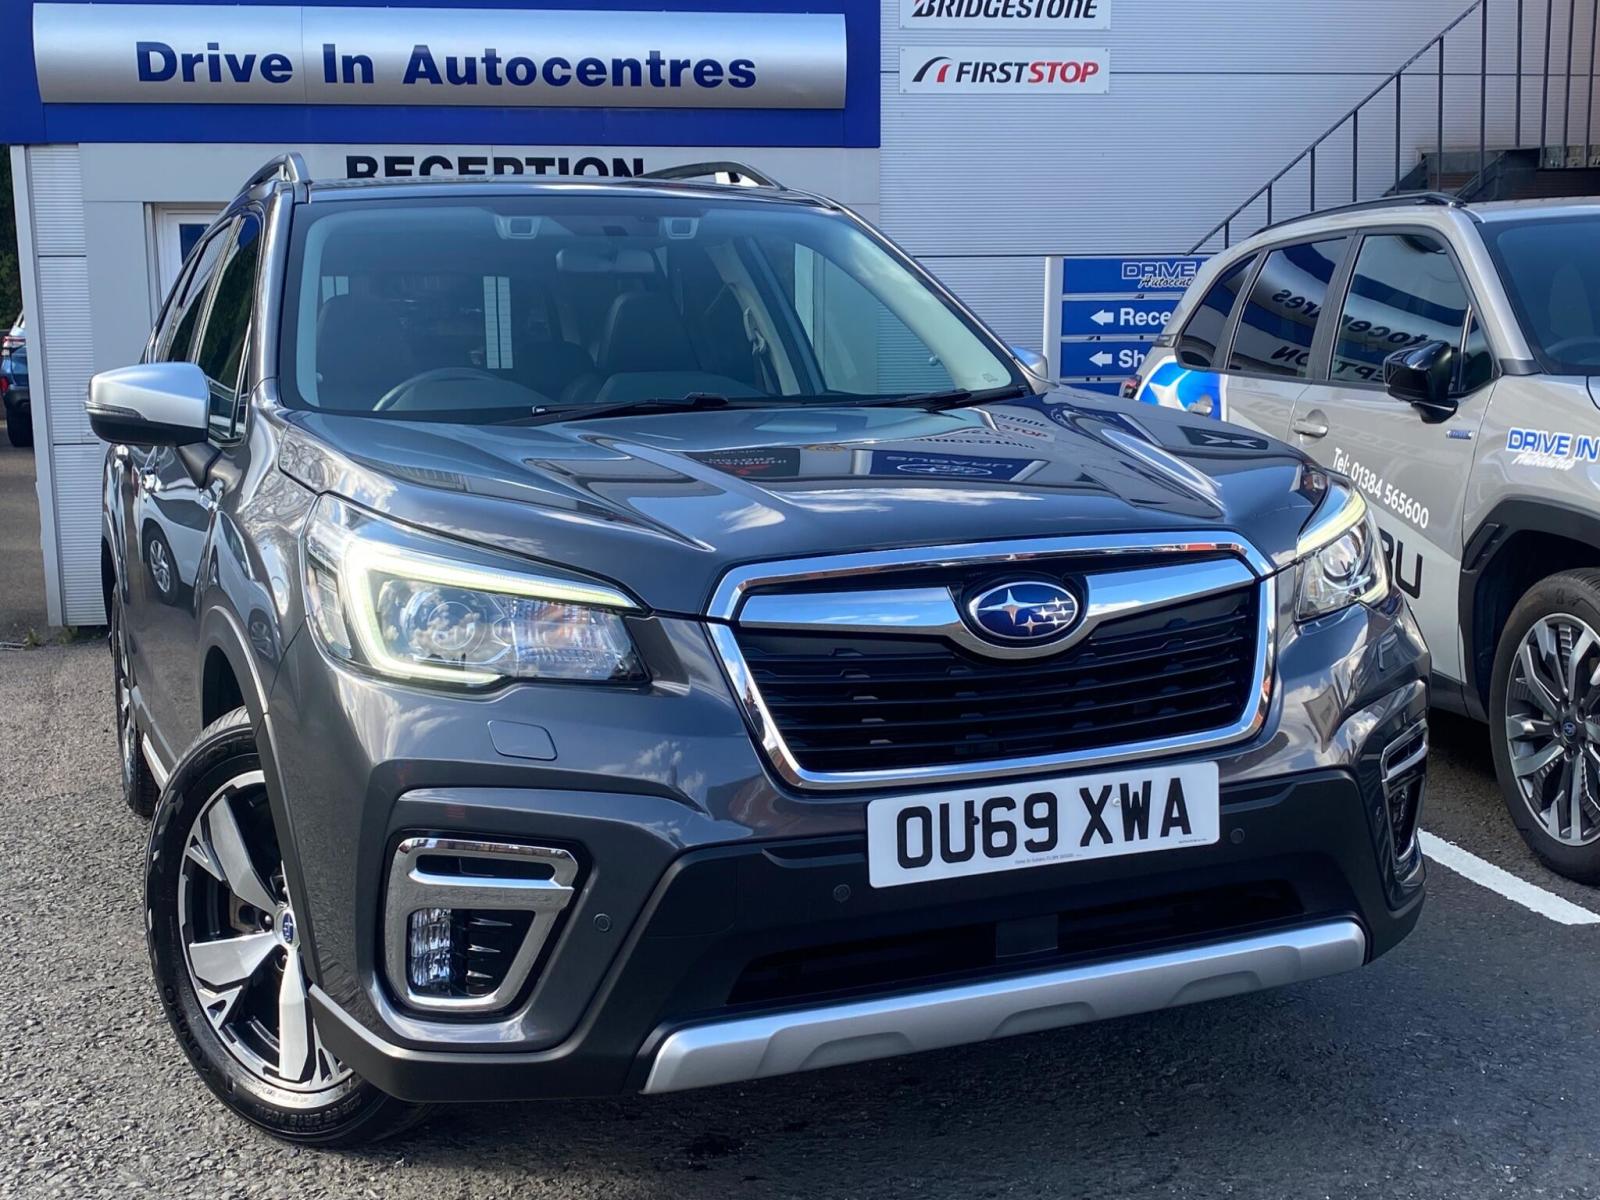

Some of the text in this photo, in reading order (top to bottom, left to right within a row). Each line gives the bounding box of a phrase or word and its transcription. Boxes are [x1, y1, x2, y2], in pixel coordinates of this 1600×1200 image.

[136, 41, 757, 88] Drive In Autocentres
[1121, 261, 1197, 280] DRIVE
[1506, 428, 1573, 457] DRIVE
[1574, 435, 1600, 462] IN
[1332, 447, 1430, 529] Tel: 01384 565600
[896, 777, 1192, 869] OU69 XWA
